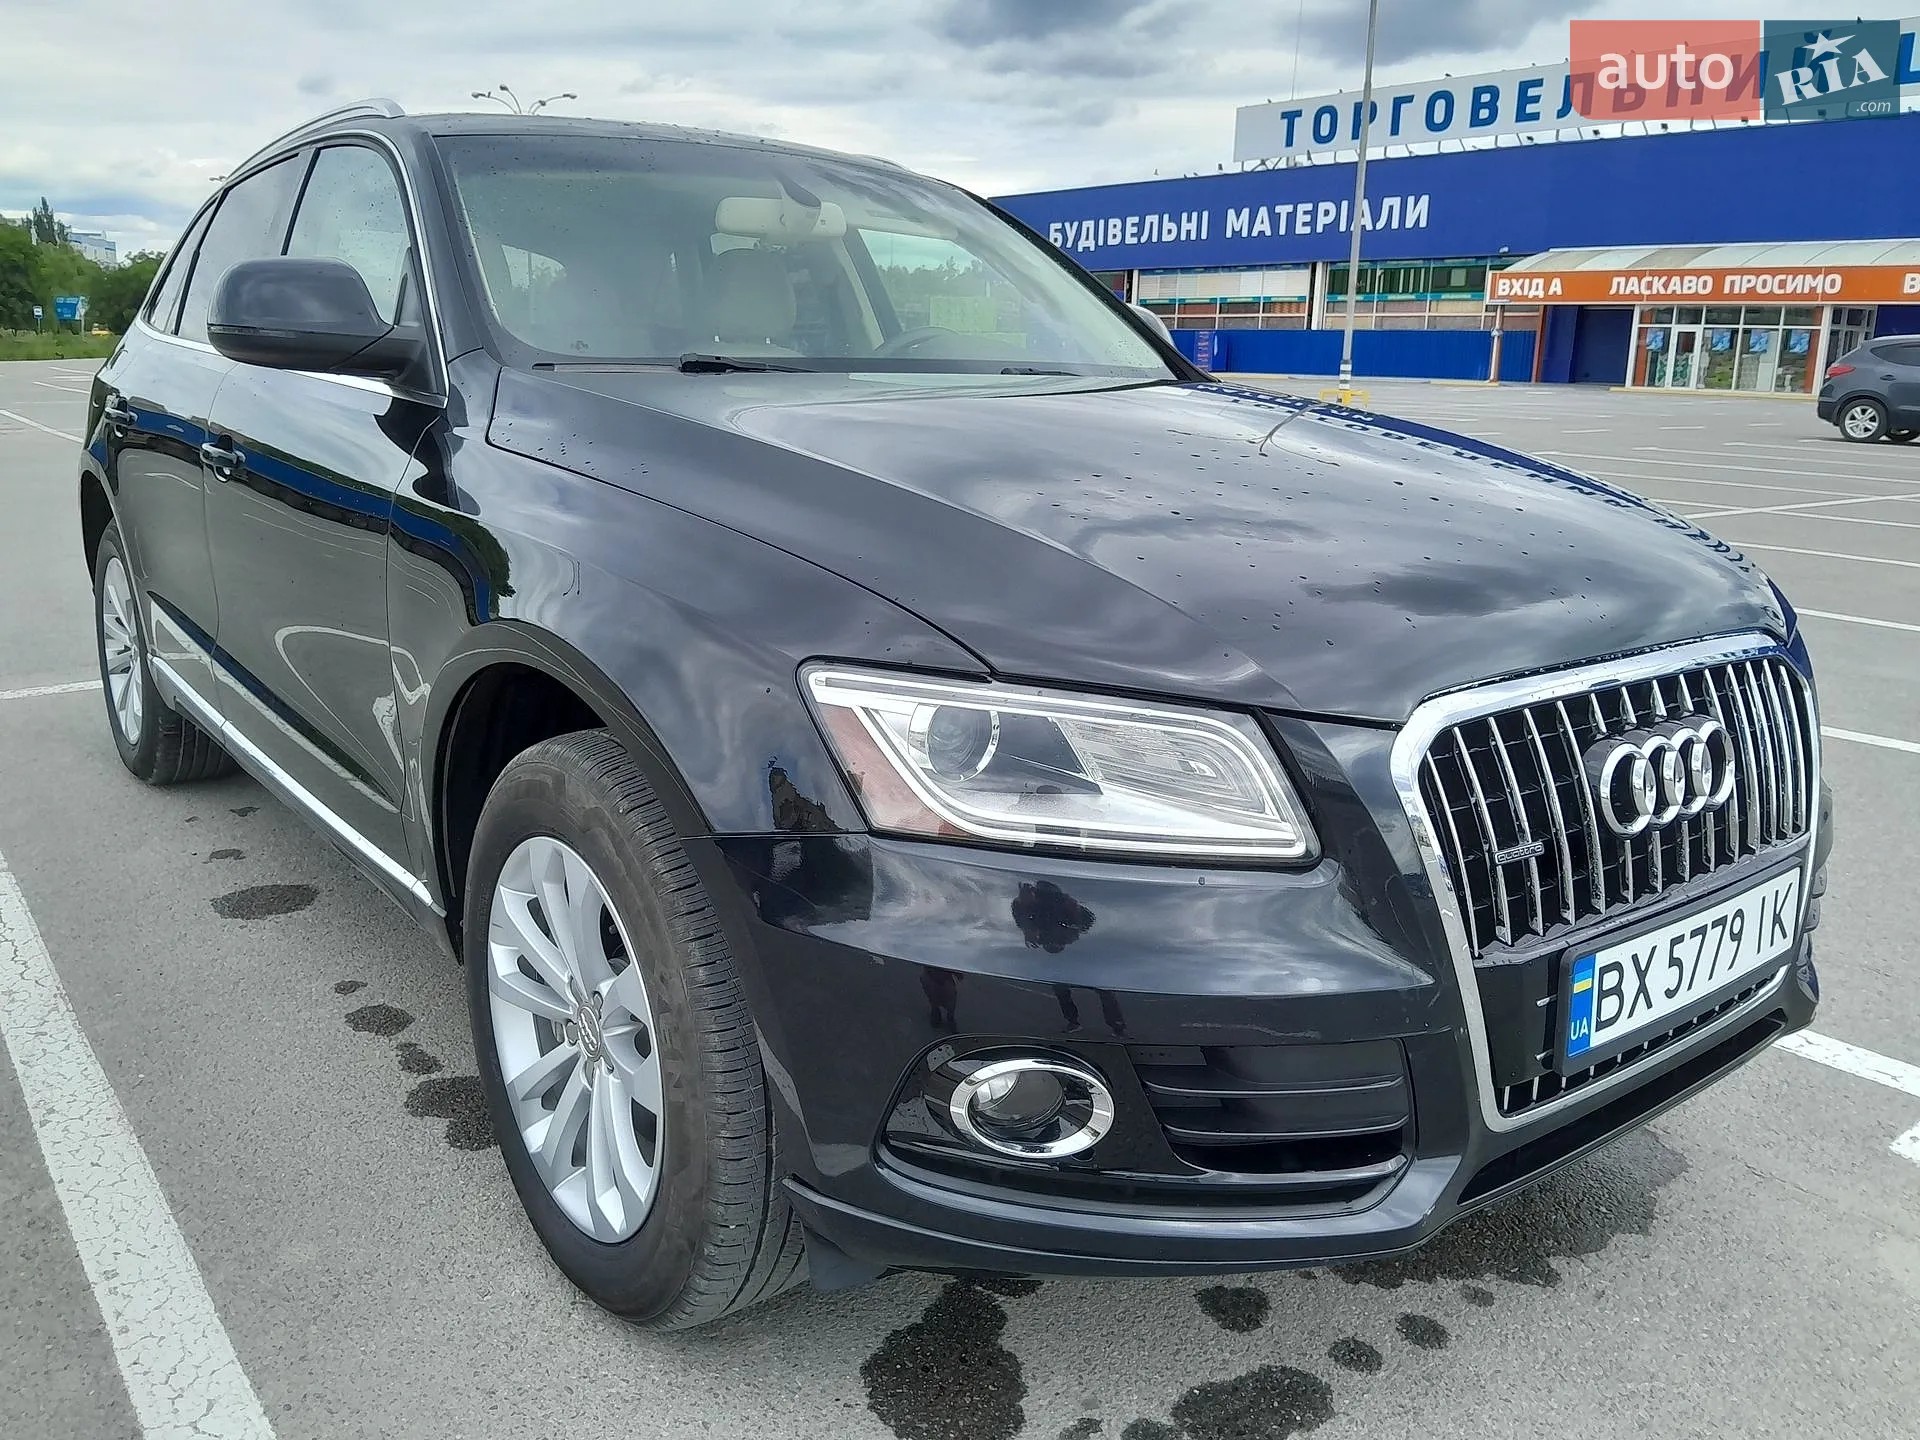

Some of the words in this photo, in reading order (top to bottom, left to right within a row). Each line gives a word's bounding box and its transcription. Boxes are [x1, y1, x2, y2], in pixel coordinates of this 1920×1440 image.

[1049, 210, 1209, 252] БУДІВЕЛЬНІ
[1225, 194, 1430, 239] МАТЕРІАЛИ
[1497, 277, 1545, 299] ВХІД
[1547, 278, 1563, 296] А
[1608, 274, 1714, 296] ЛАСКАВО
[1722, 273, 1842, 295] ПРОСИМО
[1497, 845, 1542, 862] quattro
[1595, 945, 1658, 1034] BX
[1664, 908, 1746, 1000] 5779
[1755, 880, 1796, 956] IK
[1571, 1017, 1590, 1041] UA
